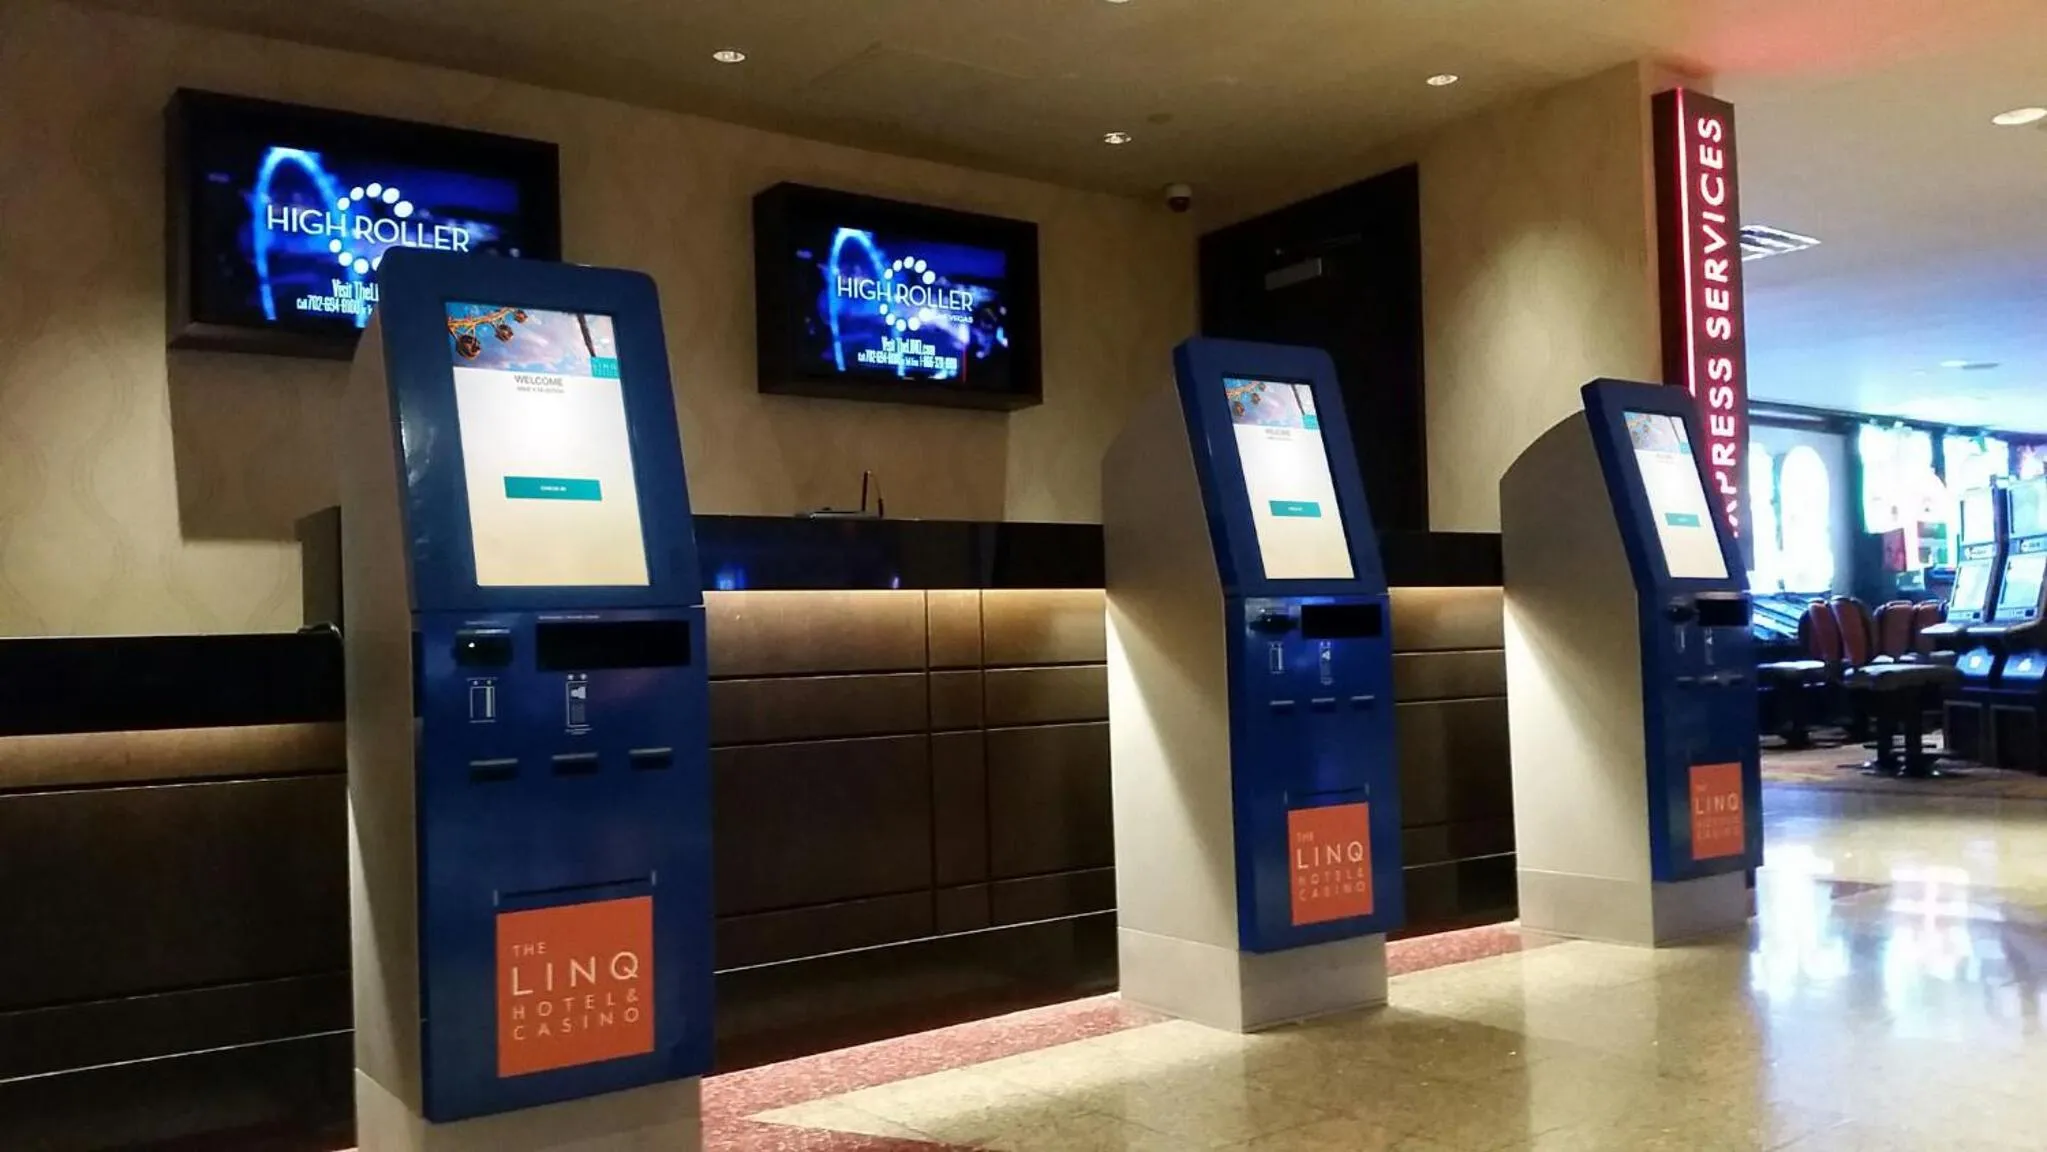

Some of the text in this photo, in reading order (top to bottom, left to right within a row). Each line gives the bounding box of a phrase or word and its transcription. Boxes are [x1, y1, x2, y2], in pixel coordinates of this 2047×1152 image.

[267, 204, 470, 253] HIGH ROLLER
[1698, 117, 1731, 341] SERVICES
[332, 278, 353, 299] Visit
[836, 275, 974, 312] HIGH ROLLER
[514, 375, 563, 386] WELCOME
[1296, 840, 1364, 870] LINQ
[512, 941, 547, 958] THE
[512, 951, 639, 996] LINQ
[513, 1007, 640, 1041] CASINO
